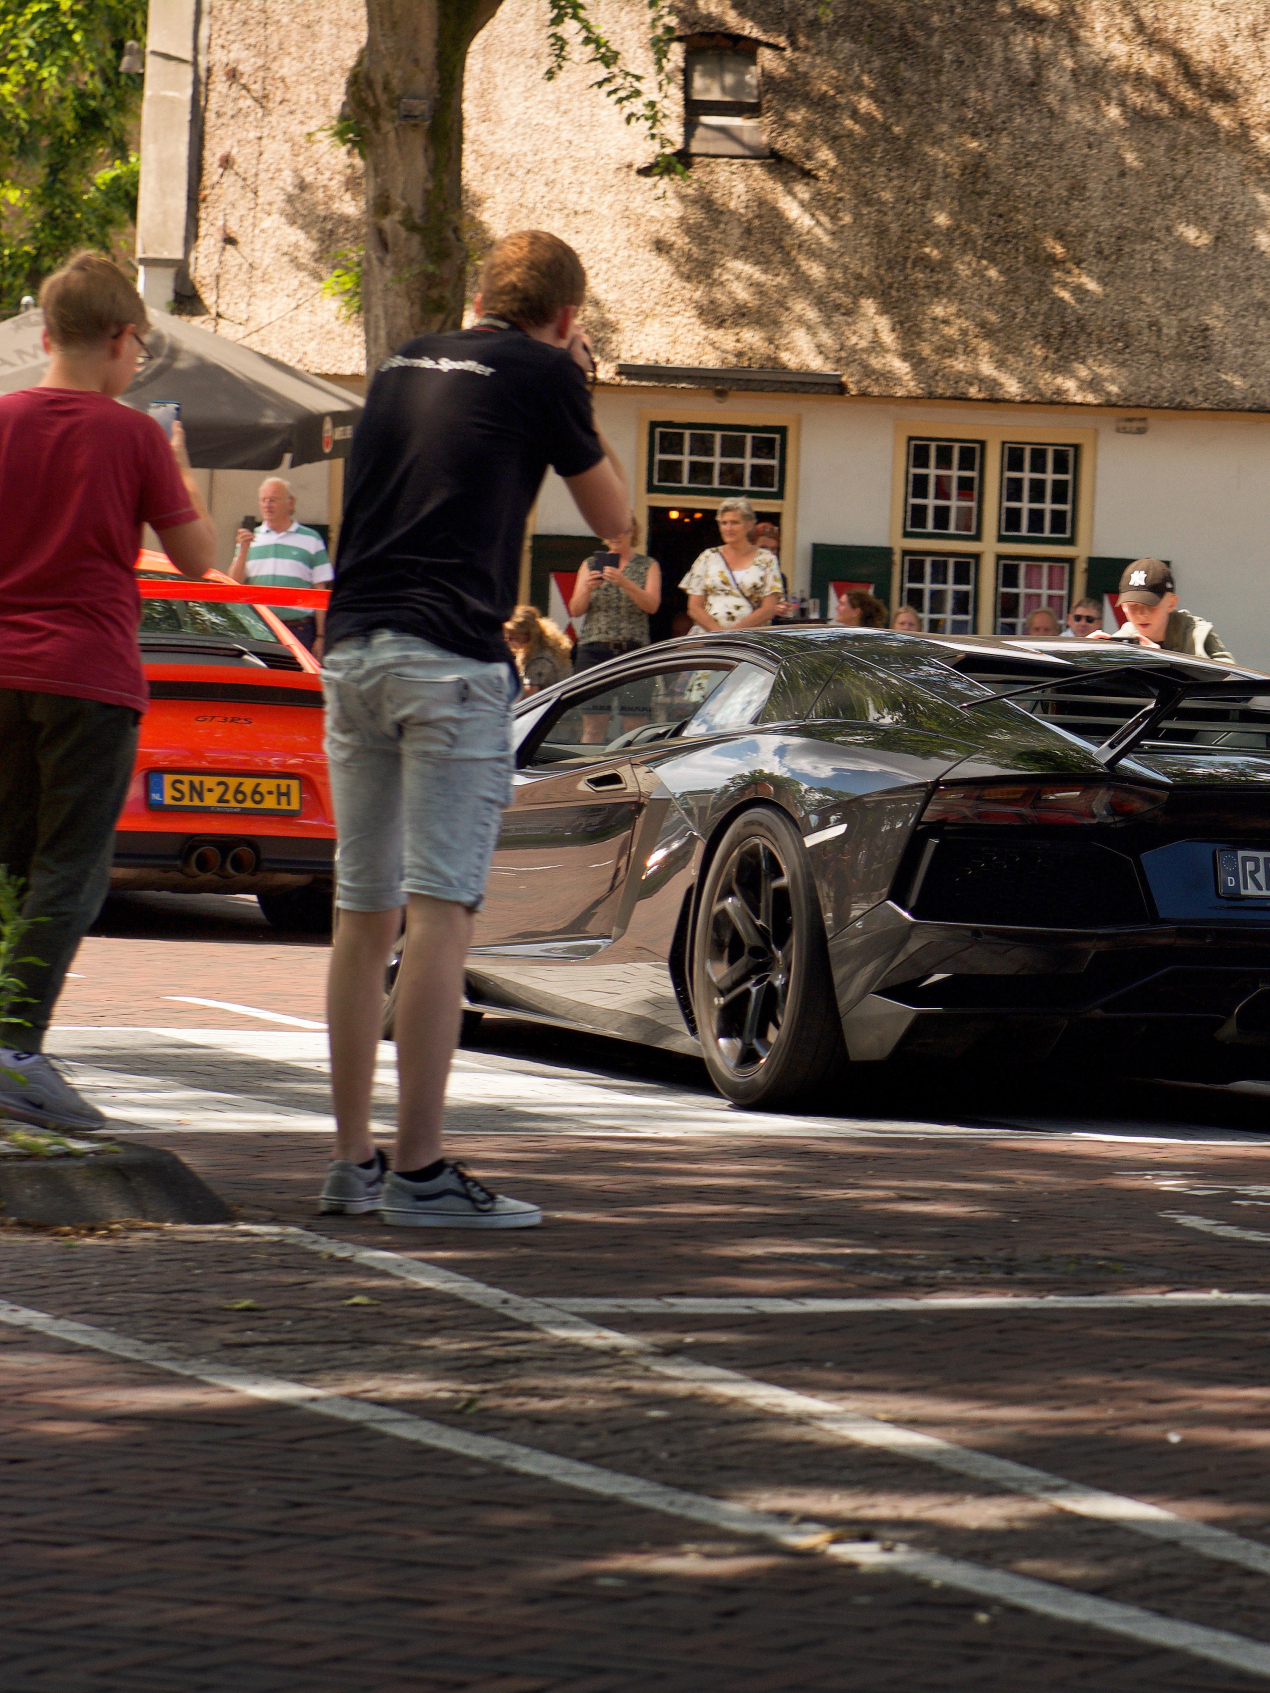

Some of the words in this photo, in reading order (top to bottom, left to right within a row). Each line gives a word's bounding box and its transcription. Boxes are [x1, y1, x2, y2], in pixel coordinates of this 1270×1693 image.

[151, 793, 163, 801] NL
[170, 779, 292, 807] SN-266-H
[1227, 876, 1235, 887] D
